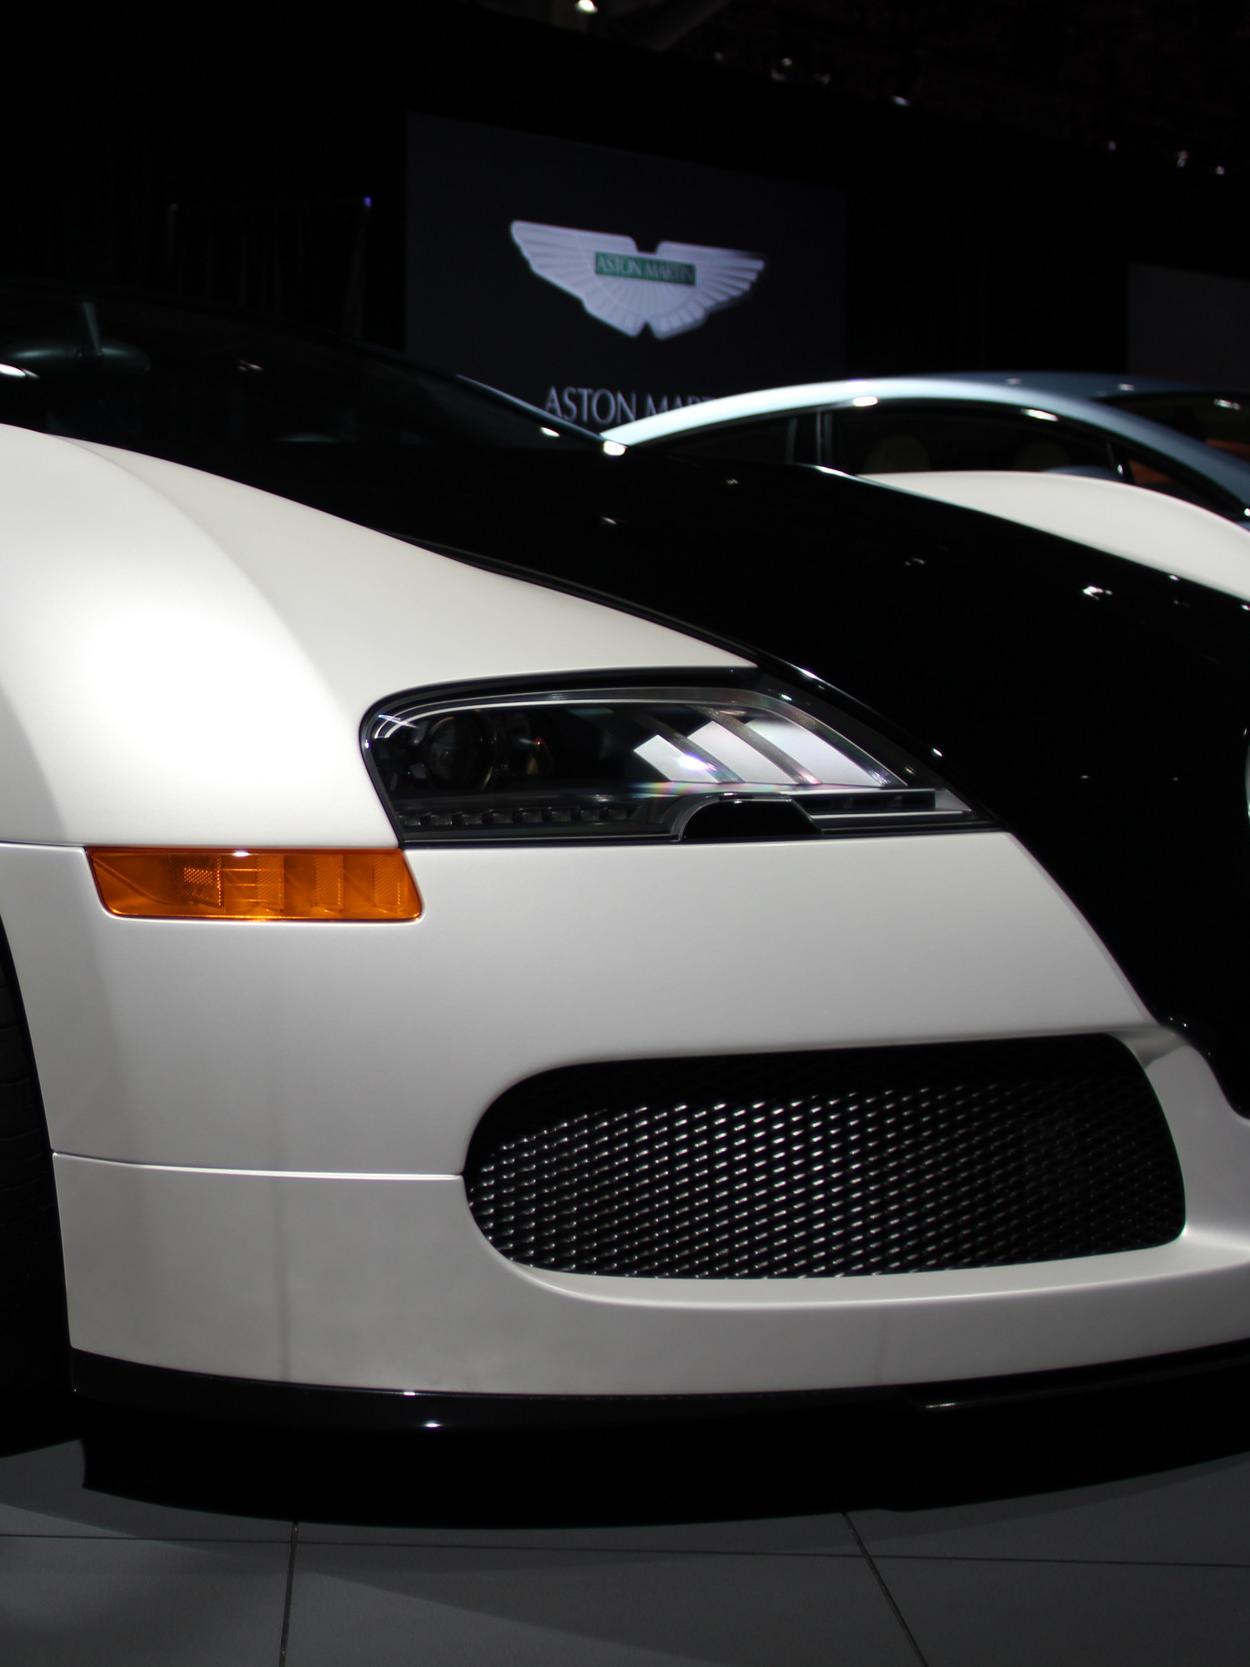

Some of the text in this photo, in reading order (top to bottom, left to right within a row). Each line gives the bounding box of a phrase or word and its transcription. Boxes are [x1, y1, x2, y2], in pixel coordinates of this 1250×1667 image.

[597, 254, 694, 283] ASTON MARTIN
[544, 385, 637, 425] ASTON
